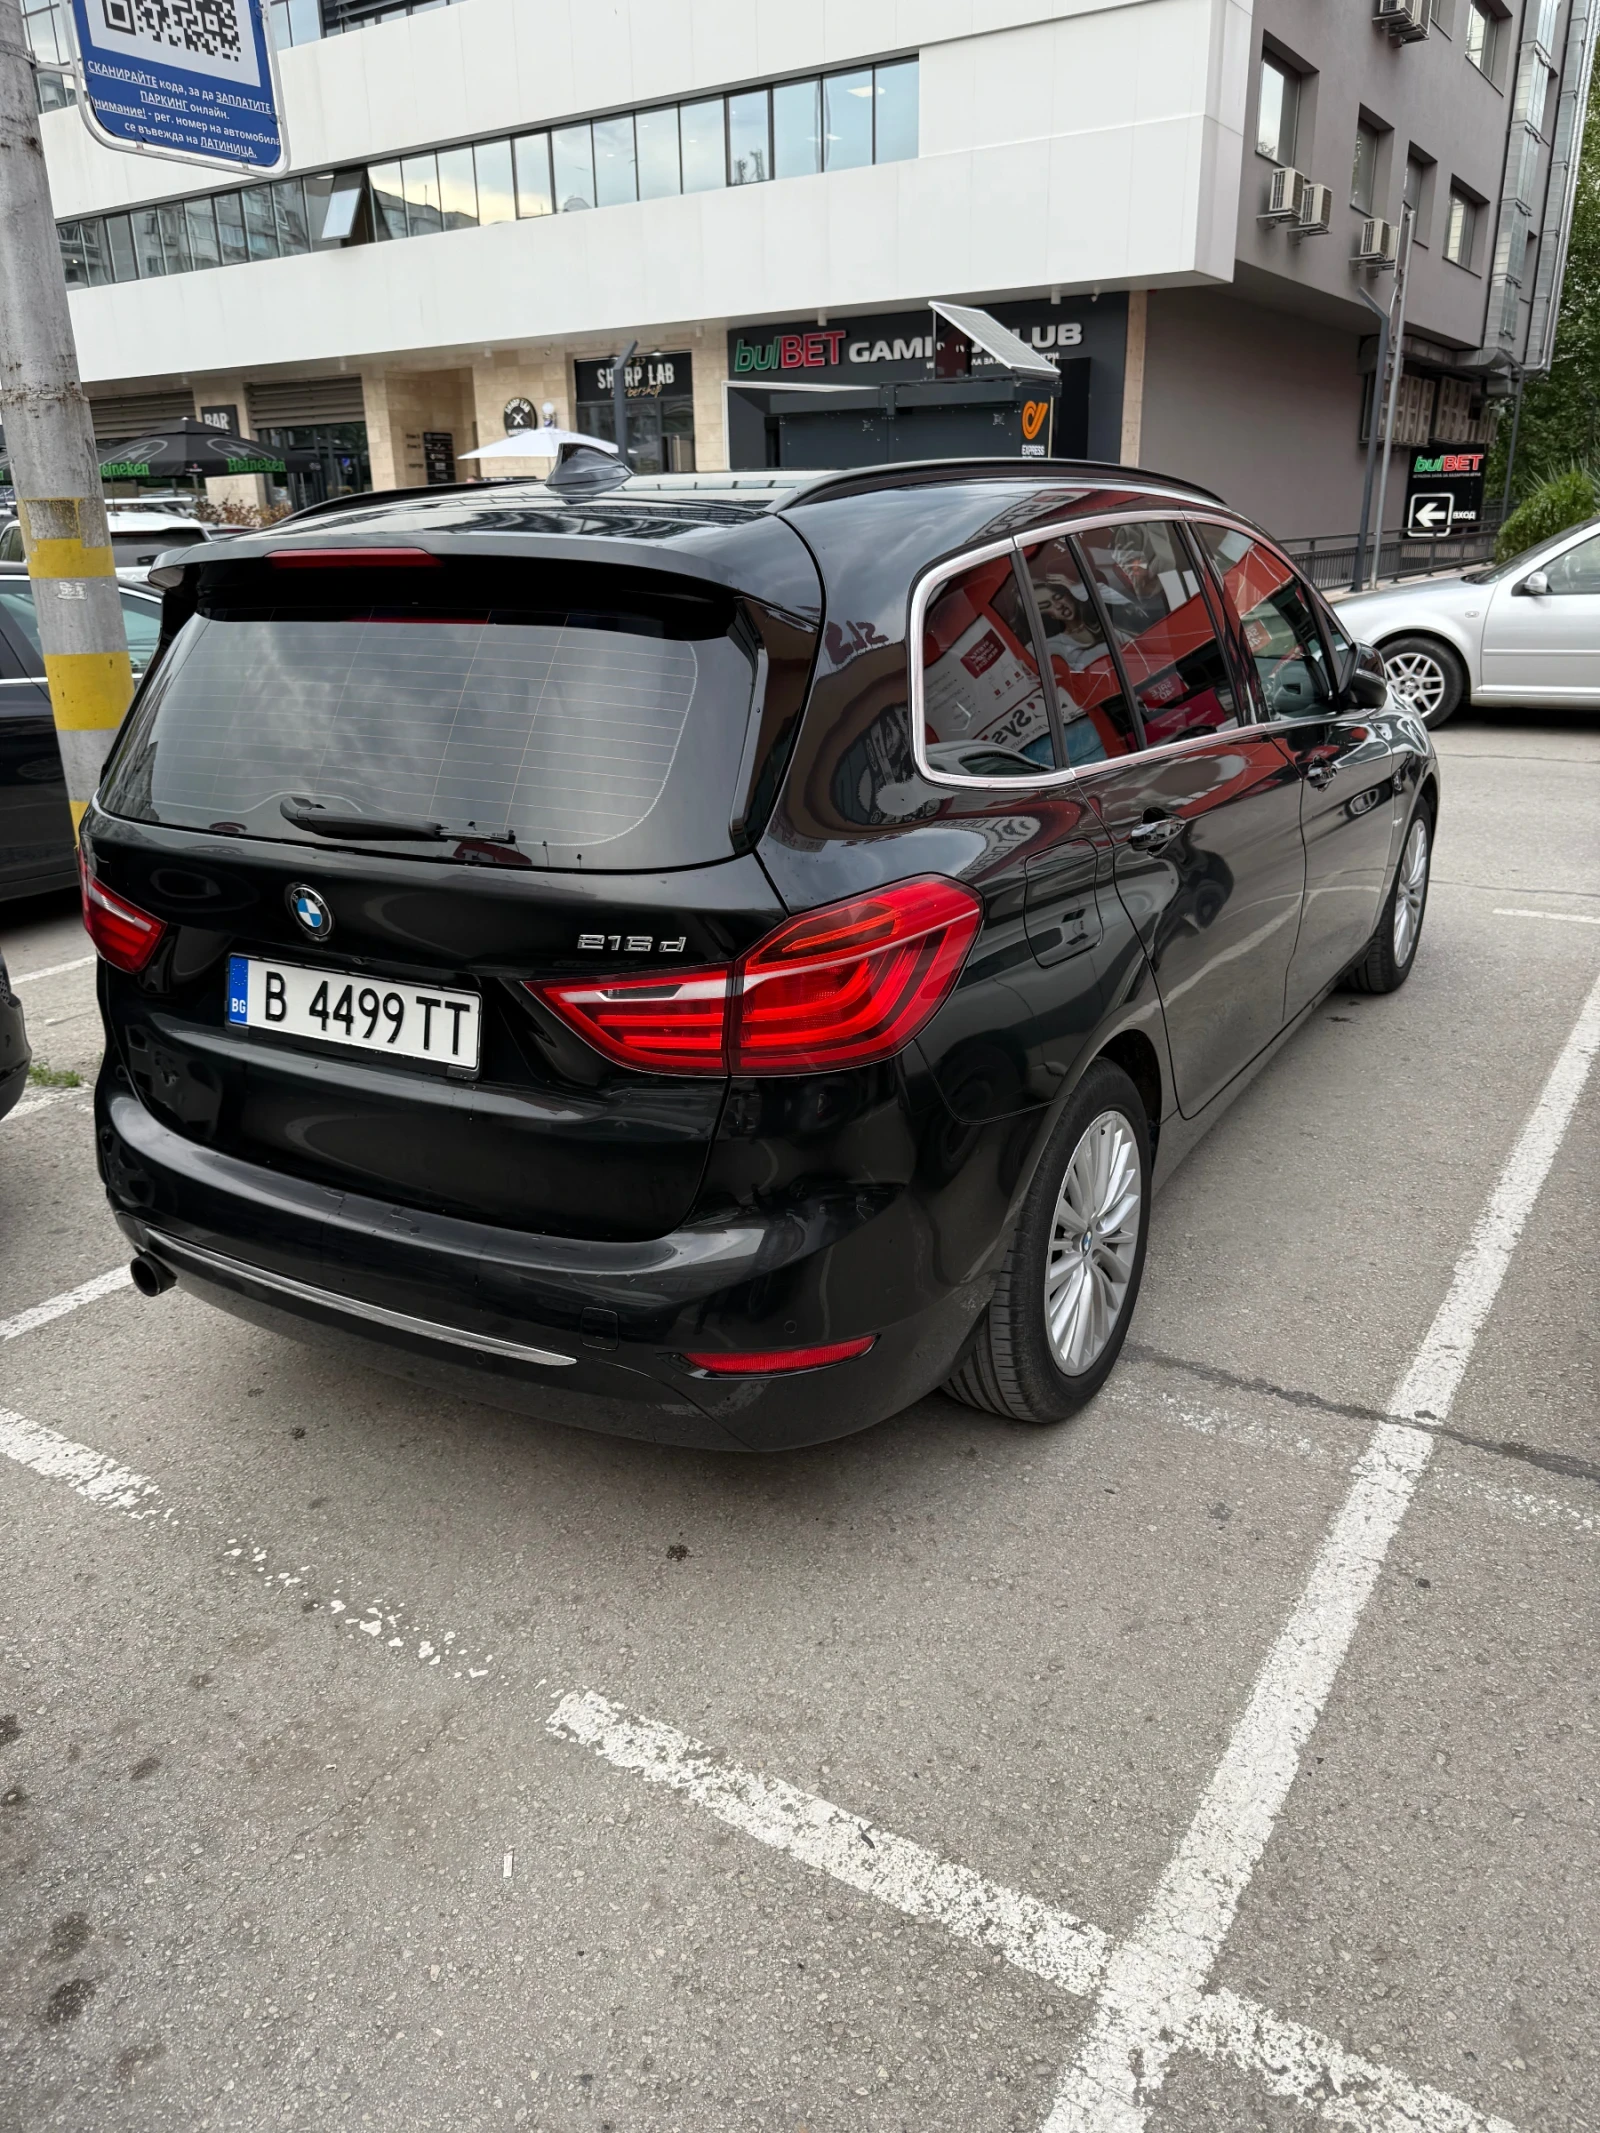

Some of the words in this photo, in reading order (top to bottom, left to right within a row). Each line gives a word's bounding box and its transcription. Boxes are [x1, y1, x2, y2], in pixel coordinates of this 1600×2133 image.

[88, 60, 158, 88] СКАНИРАЙТЕ
[159, 79, 187, 96] кода,
[189, 86, 200, 96] за
[202, 91, 214, 101] да
[216, 91, 271, 114] ЗАПЛАТИТЕ
[140, 90, 189, 112] ПАРКИНГ
[190, 103, 230, 120] онлайн.
[154, 112, 174, 124] рег.
[176, 116, 208, 132] номер
[209, 124, 222, 134] на
[124, 121, 136, 132] се
[138, 124, 184, 143] въвежда
[186, 135, 198, 145] на
[200, 136, 257, 159] ЛАТИНИЦА.
[734, 330, 846, 372] bulBET
[597, 366, 642, 389] SHRP
[648, 362, 675, 385] LAB
[204, 412, 230, 430] BAR
[1021, 444, 1045, 456] EXPRESS
[226, 458, 288, 473] Heineken
[1413, 454, 1484, 473] bulBET
[1452, 510, 1476, 520] ВХОД
[576, 935, 653, 952] 216
[658, 936, 687, 952] d
[231, 997, 246, 1014] BG
[265, 971, 287, 1022] B
[309, 980, 405, 1044] 4499
[416, 995, 471, 1056] TT
